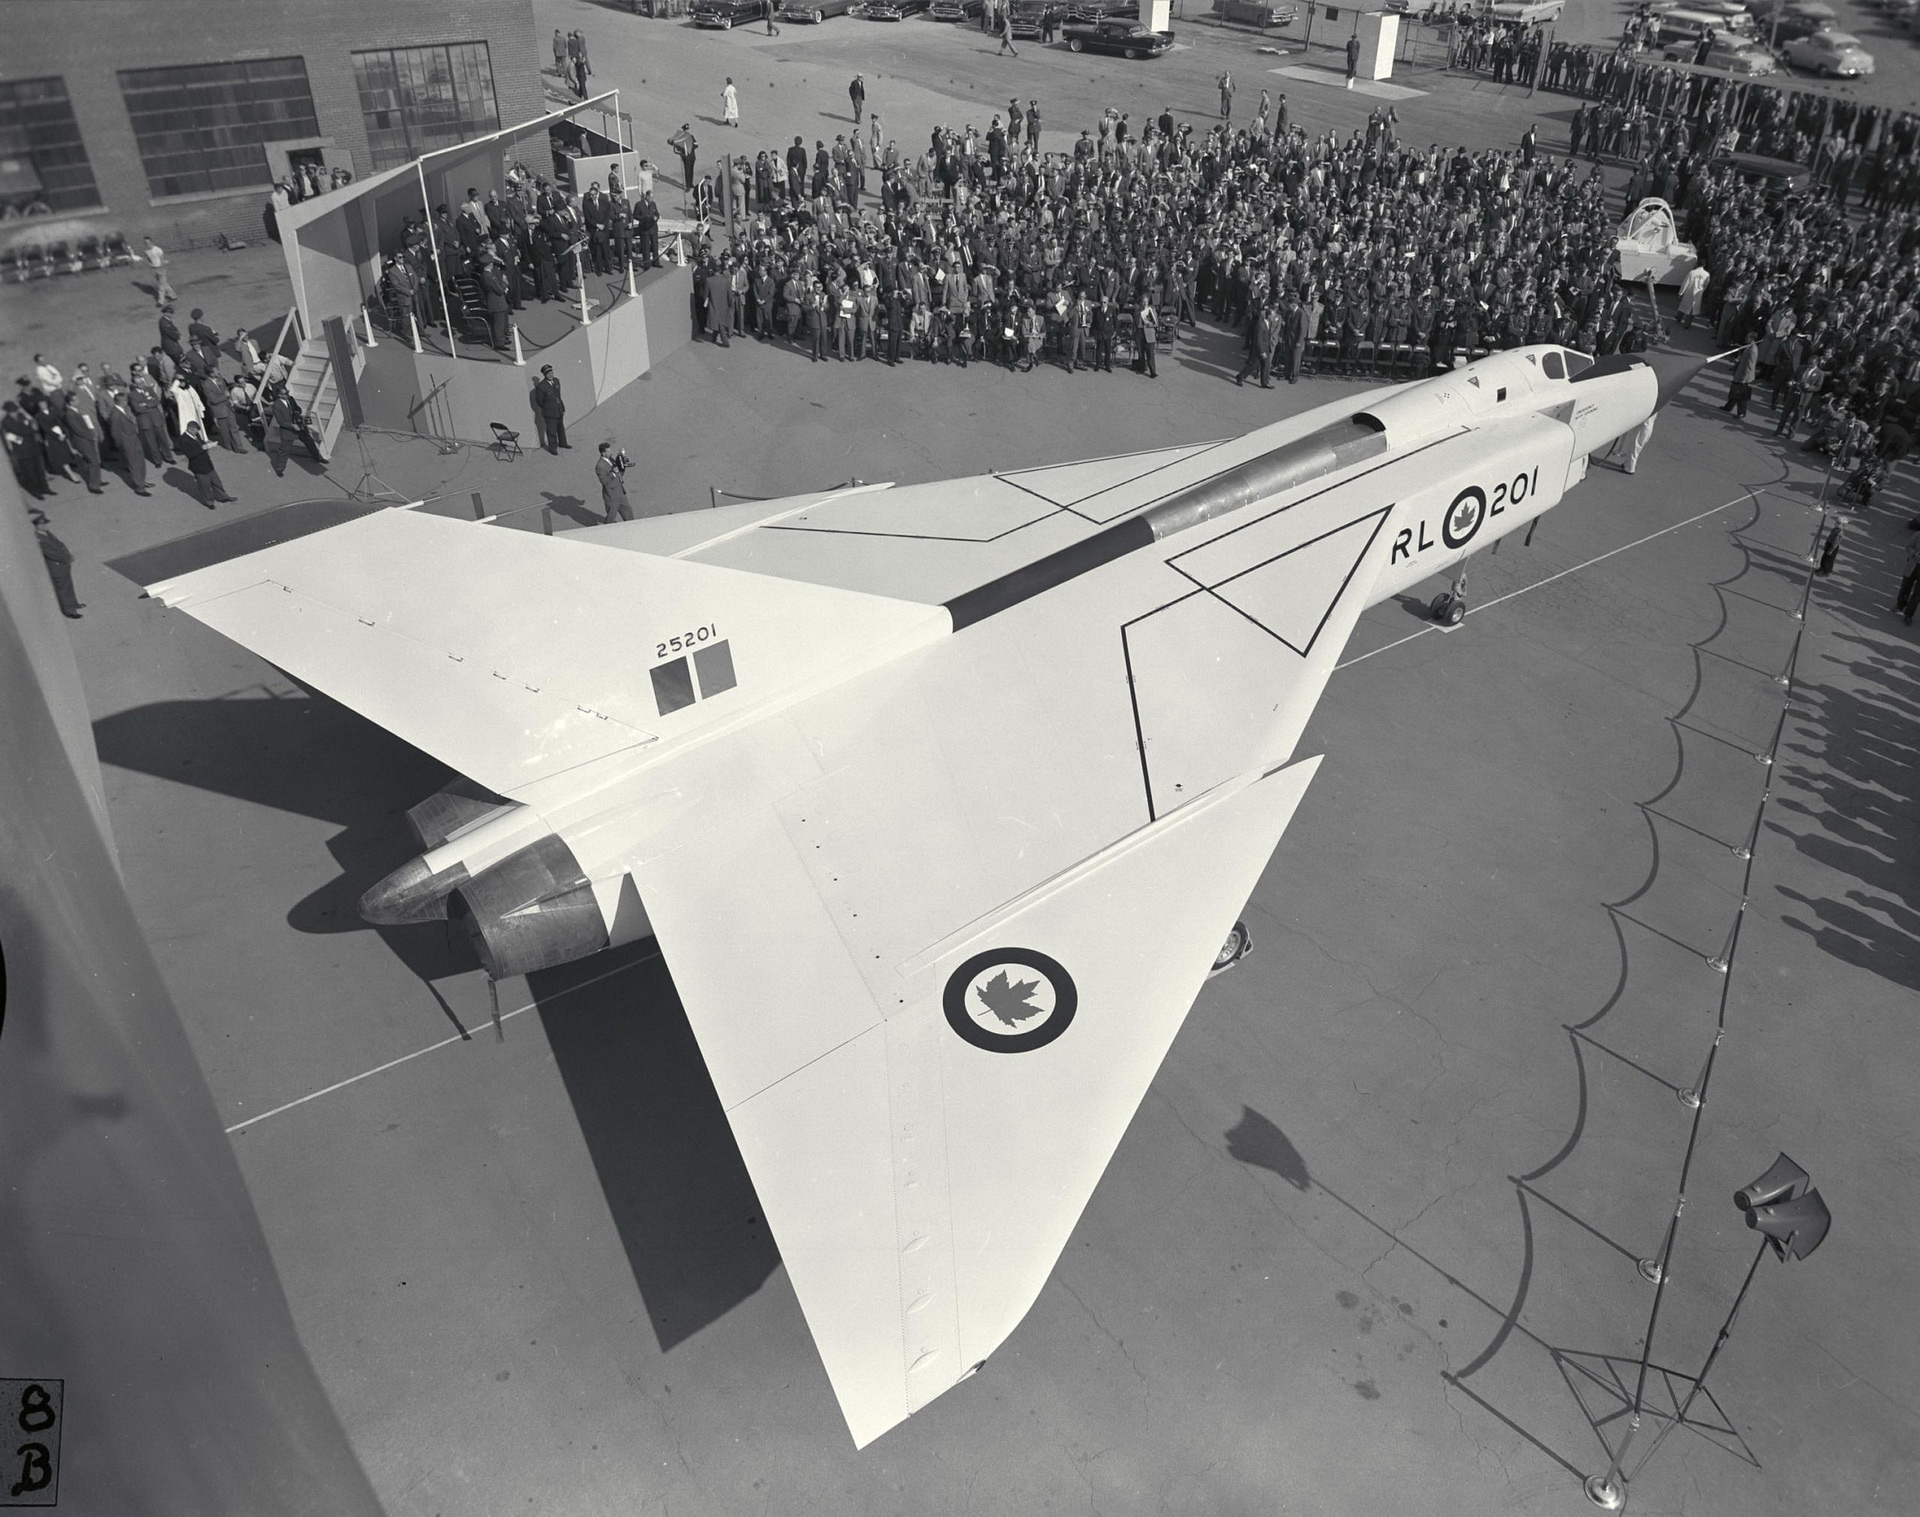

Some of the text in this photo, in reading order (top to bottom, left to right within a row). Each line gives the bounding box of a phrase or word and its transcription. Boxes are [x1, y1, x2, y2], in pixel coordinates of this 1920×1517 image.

[1391, 465, 1539, 565] RL 201
[656, 623, 717, 658] 25201
